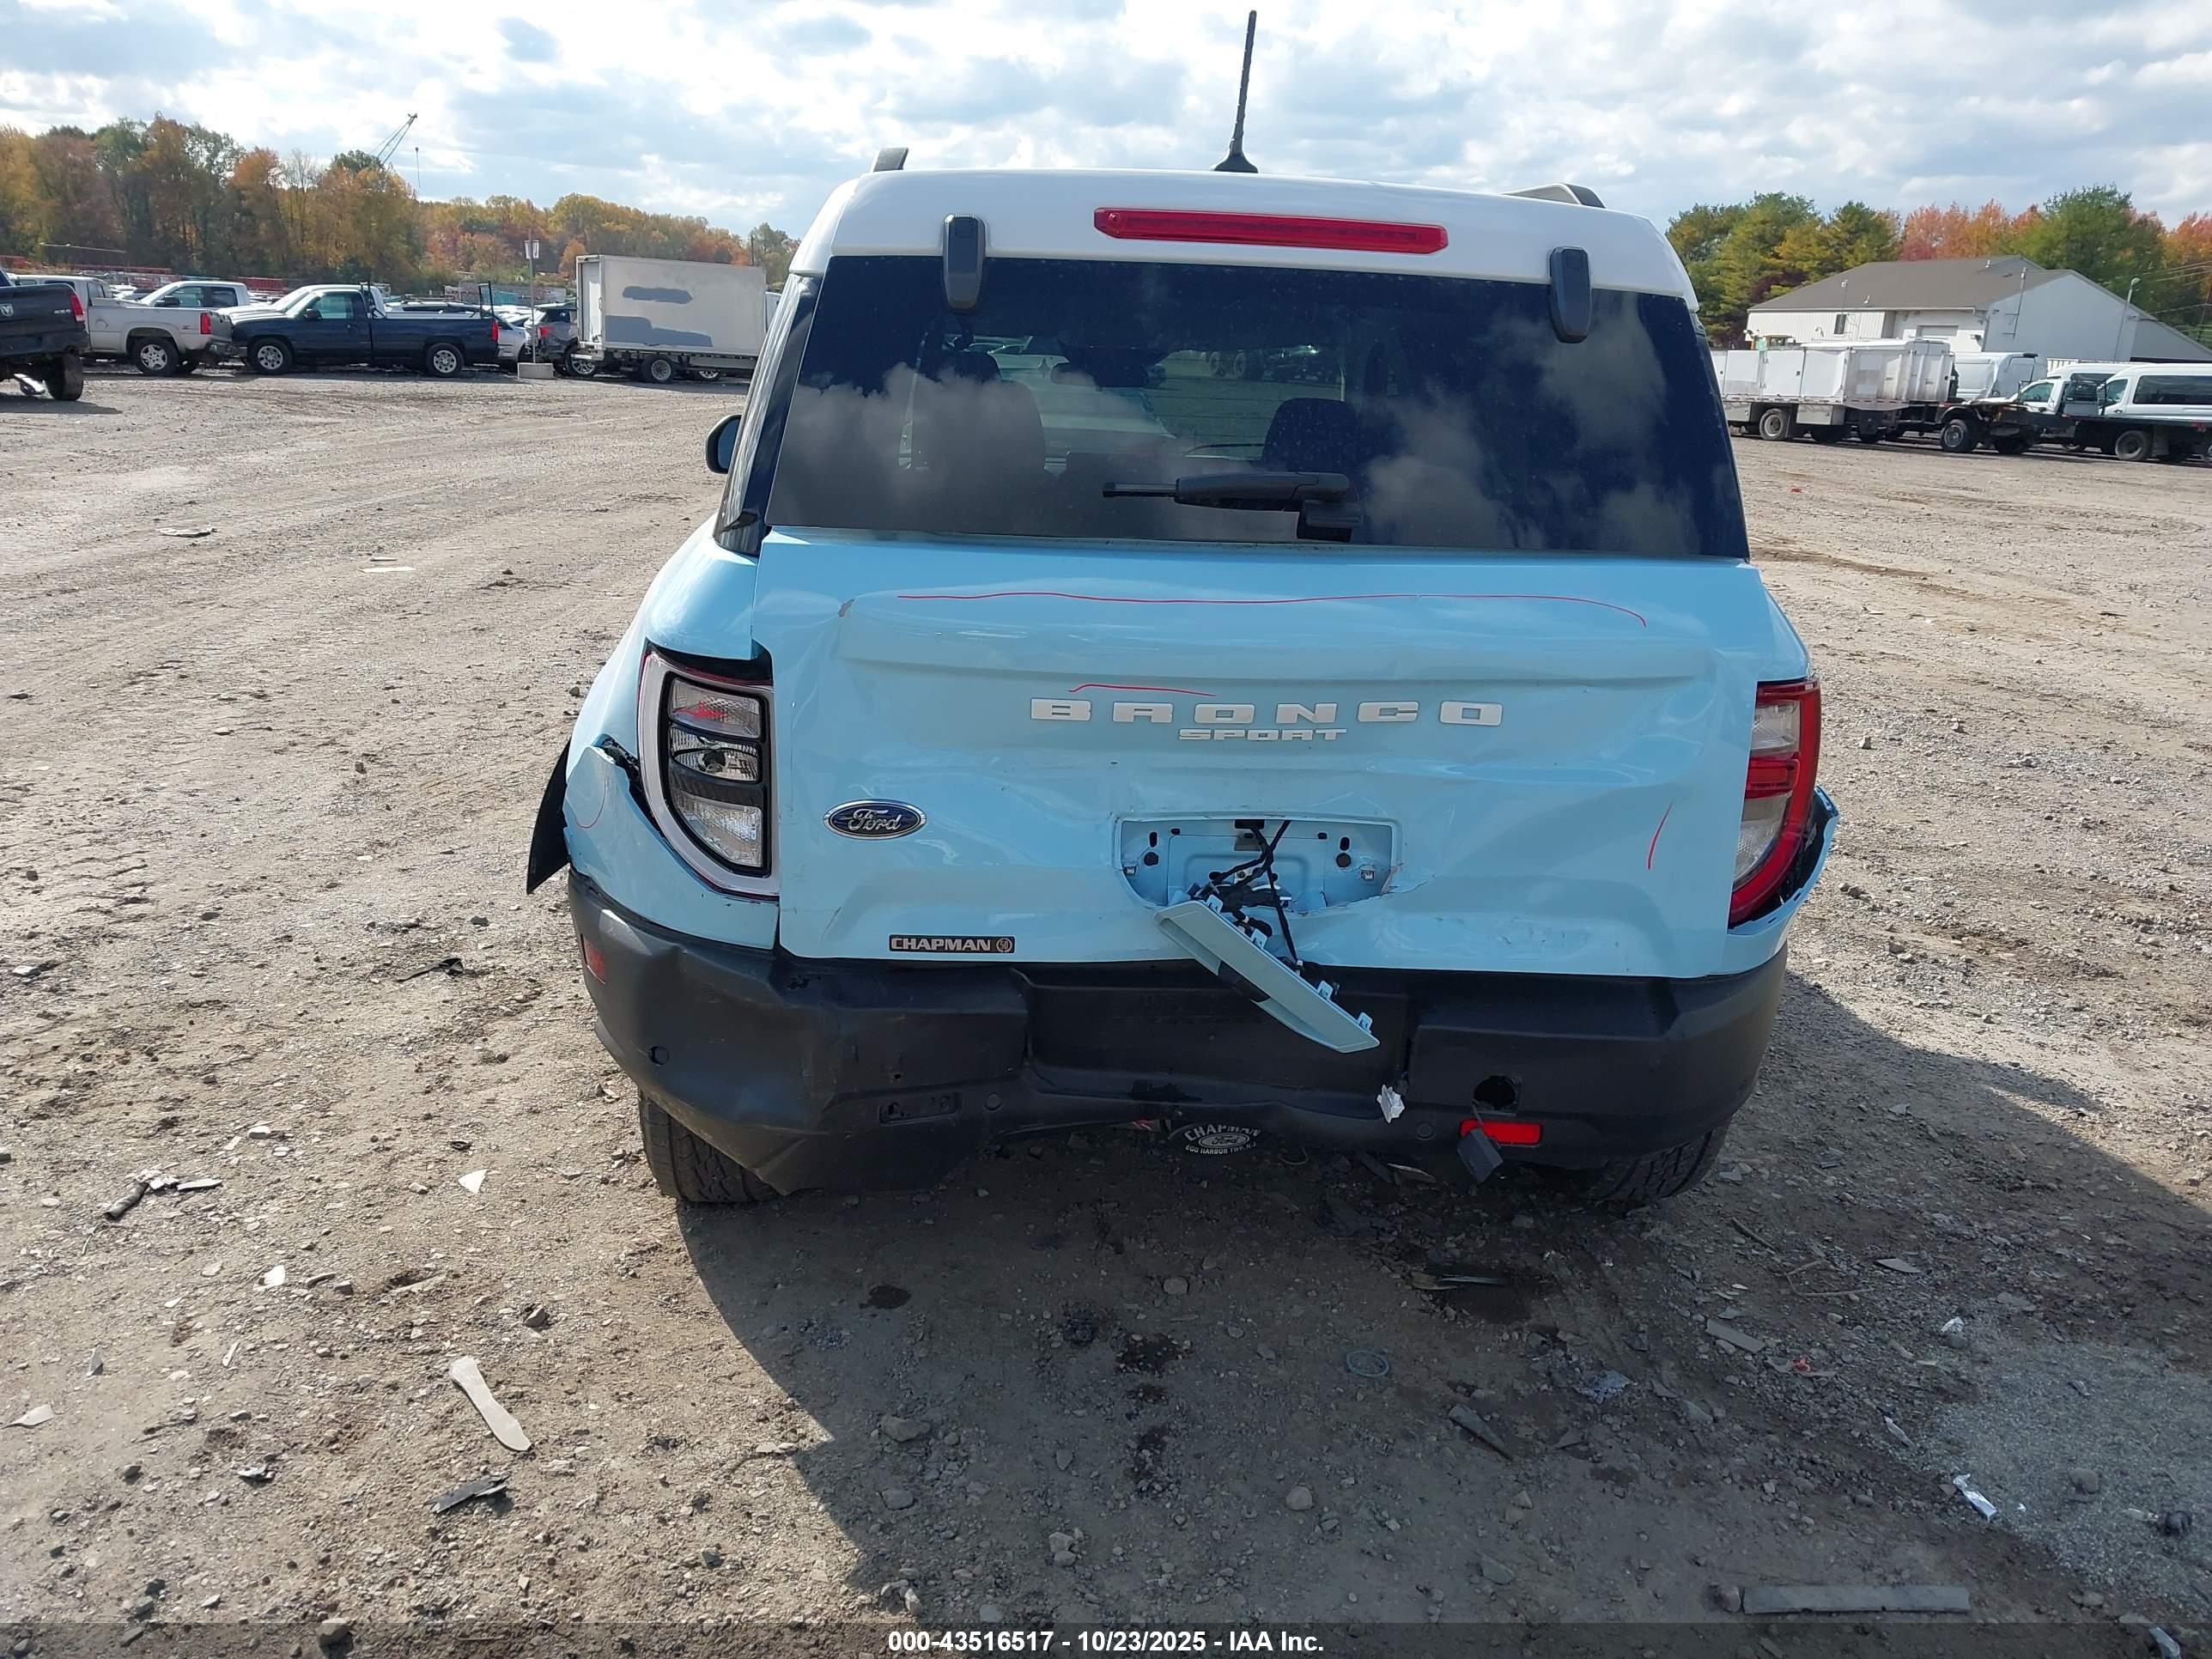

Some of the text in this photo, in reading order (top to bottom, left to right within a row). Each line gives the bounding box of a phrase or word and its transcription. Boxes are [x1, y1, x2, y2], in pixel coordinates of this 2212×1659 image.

[1030, 697, 1504, 726] BRONCO
[1177, 727, 1347, 742] SPORT
[848, 808, 902, 831] Ford
[890, 937, 991, 951] CHAPMAN
